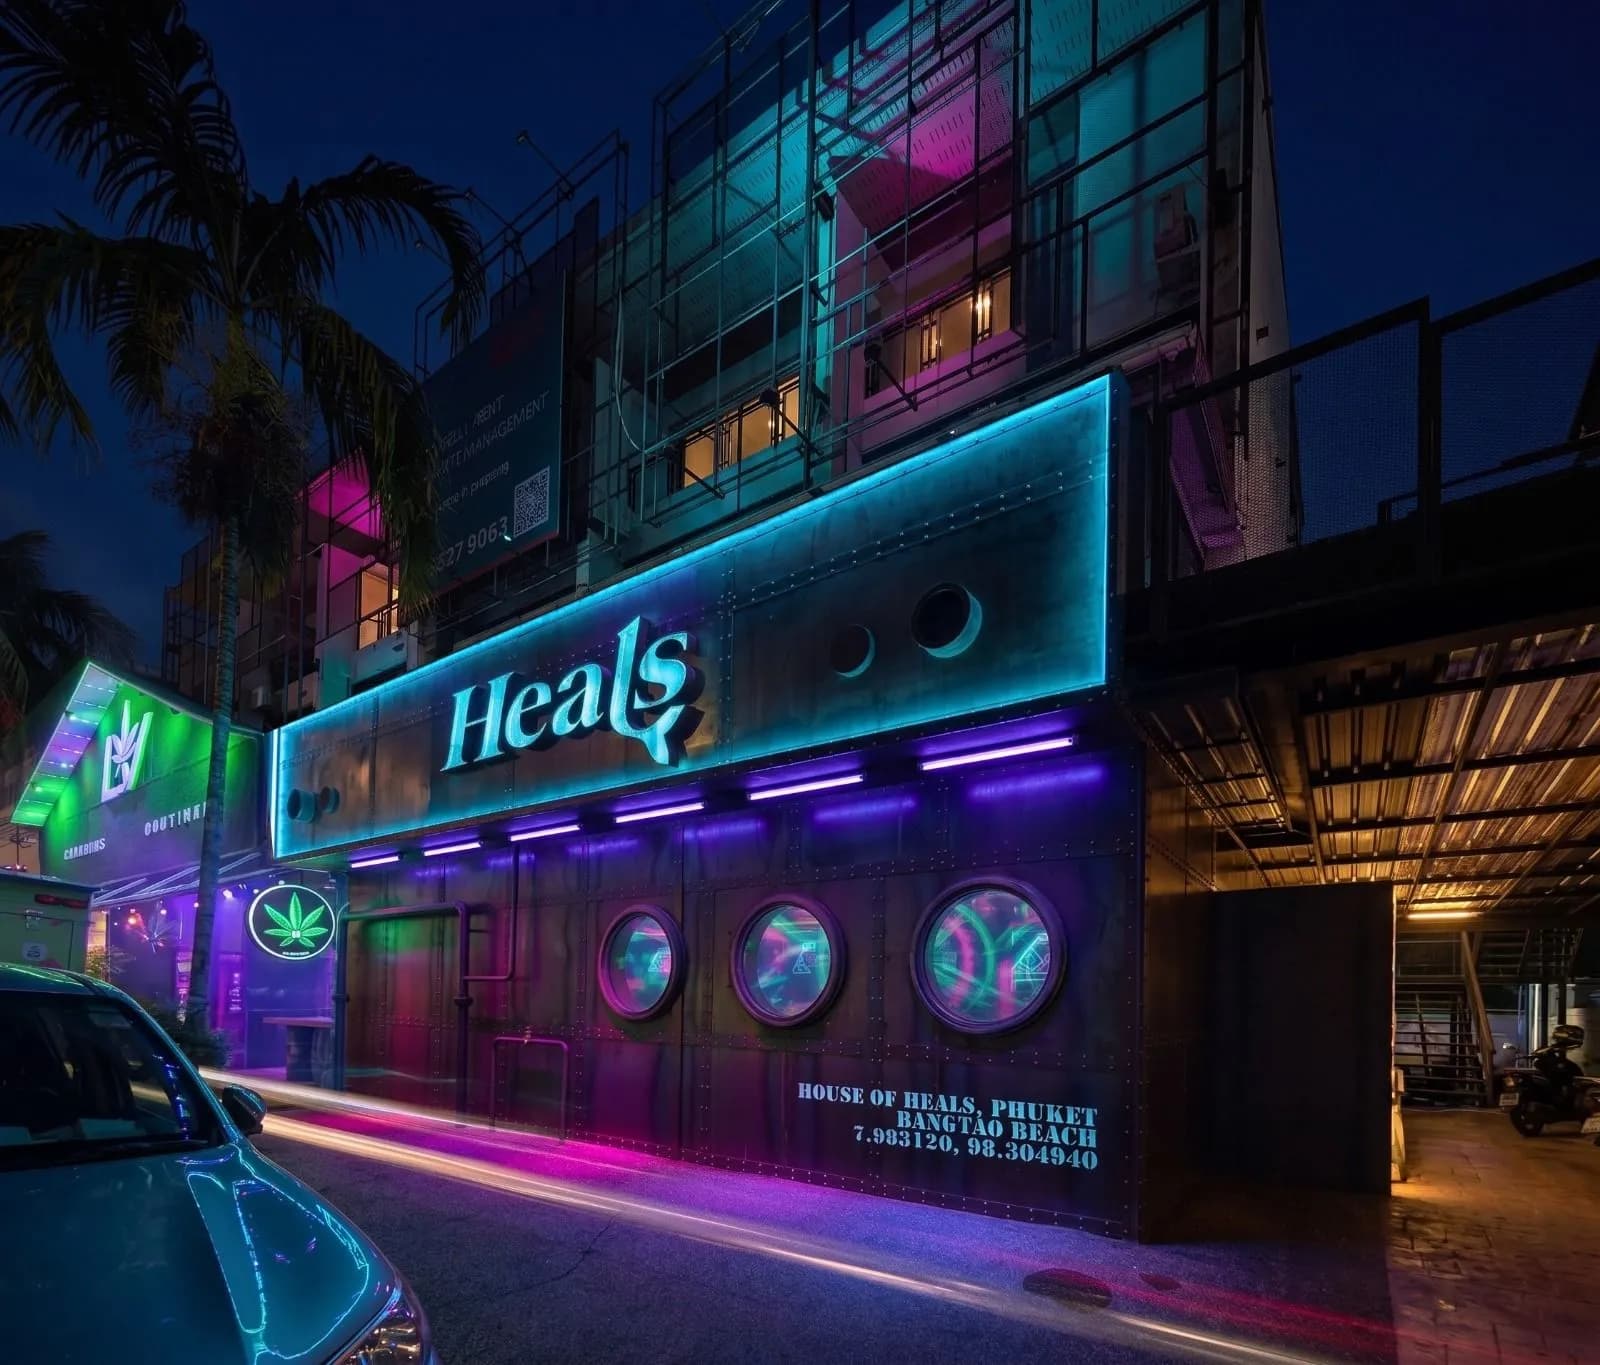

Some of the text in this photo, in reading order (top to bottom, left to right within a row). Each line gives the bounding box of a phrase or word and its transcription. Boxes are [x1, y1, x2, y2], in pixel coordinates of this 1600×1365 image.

[440, 615, 687, 771] Heals
[798, 1082, 1098, 1127] HOUSE OF HEALS, PHUKET
[853, 1125, 1098, 1170] 7.983120, 98.304940
[897, 1111, 1097, 1148] BANGTAO BEACH
